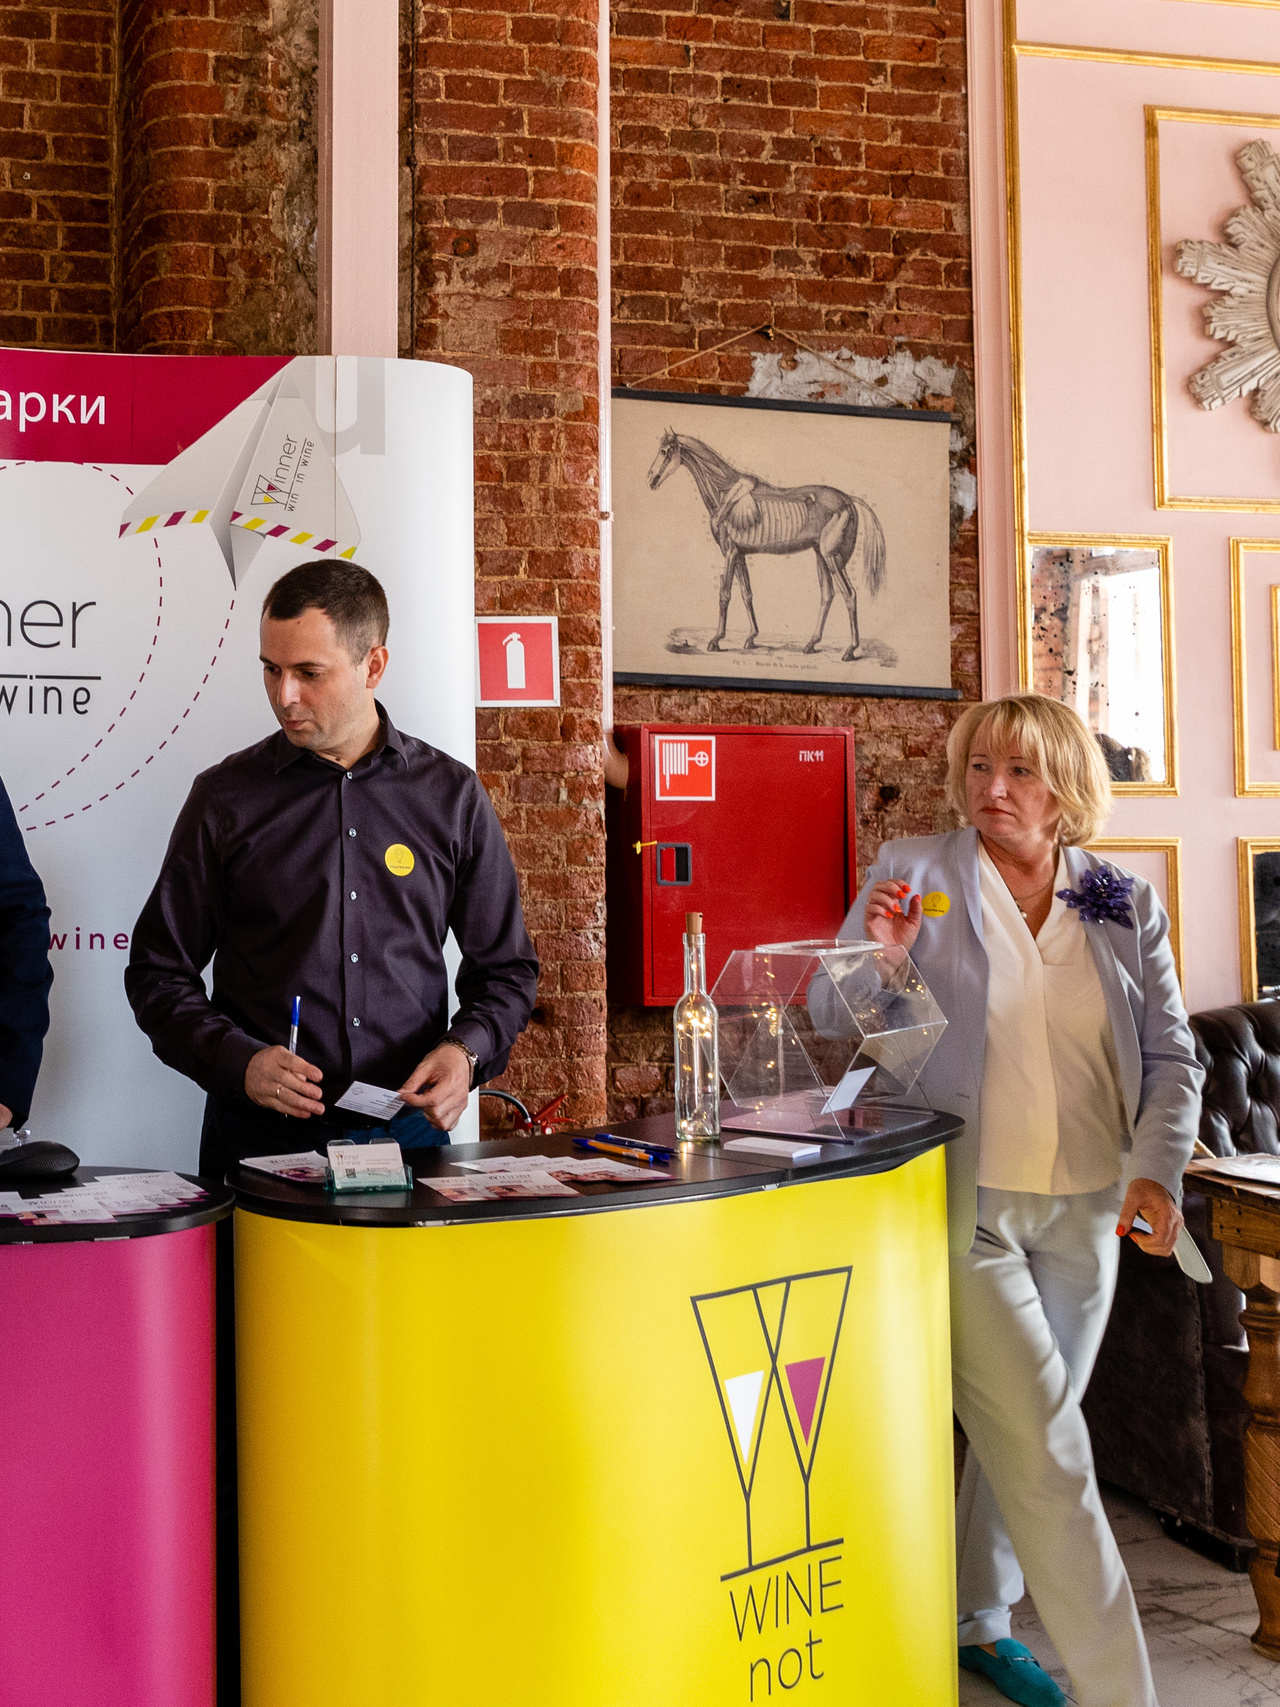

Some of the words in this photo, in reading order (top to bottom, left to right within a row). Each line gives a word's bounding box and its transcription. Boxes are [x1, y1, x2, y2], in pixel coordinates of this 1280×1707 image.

[300, 440, 315, 468] wine
[295, 473, 306, 484] in
[286, 493, 300, 512] win
[729, 1556, 844, 1642] WINE
[750, 1629, 825, 1702] not
